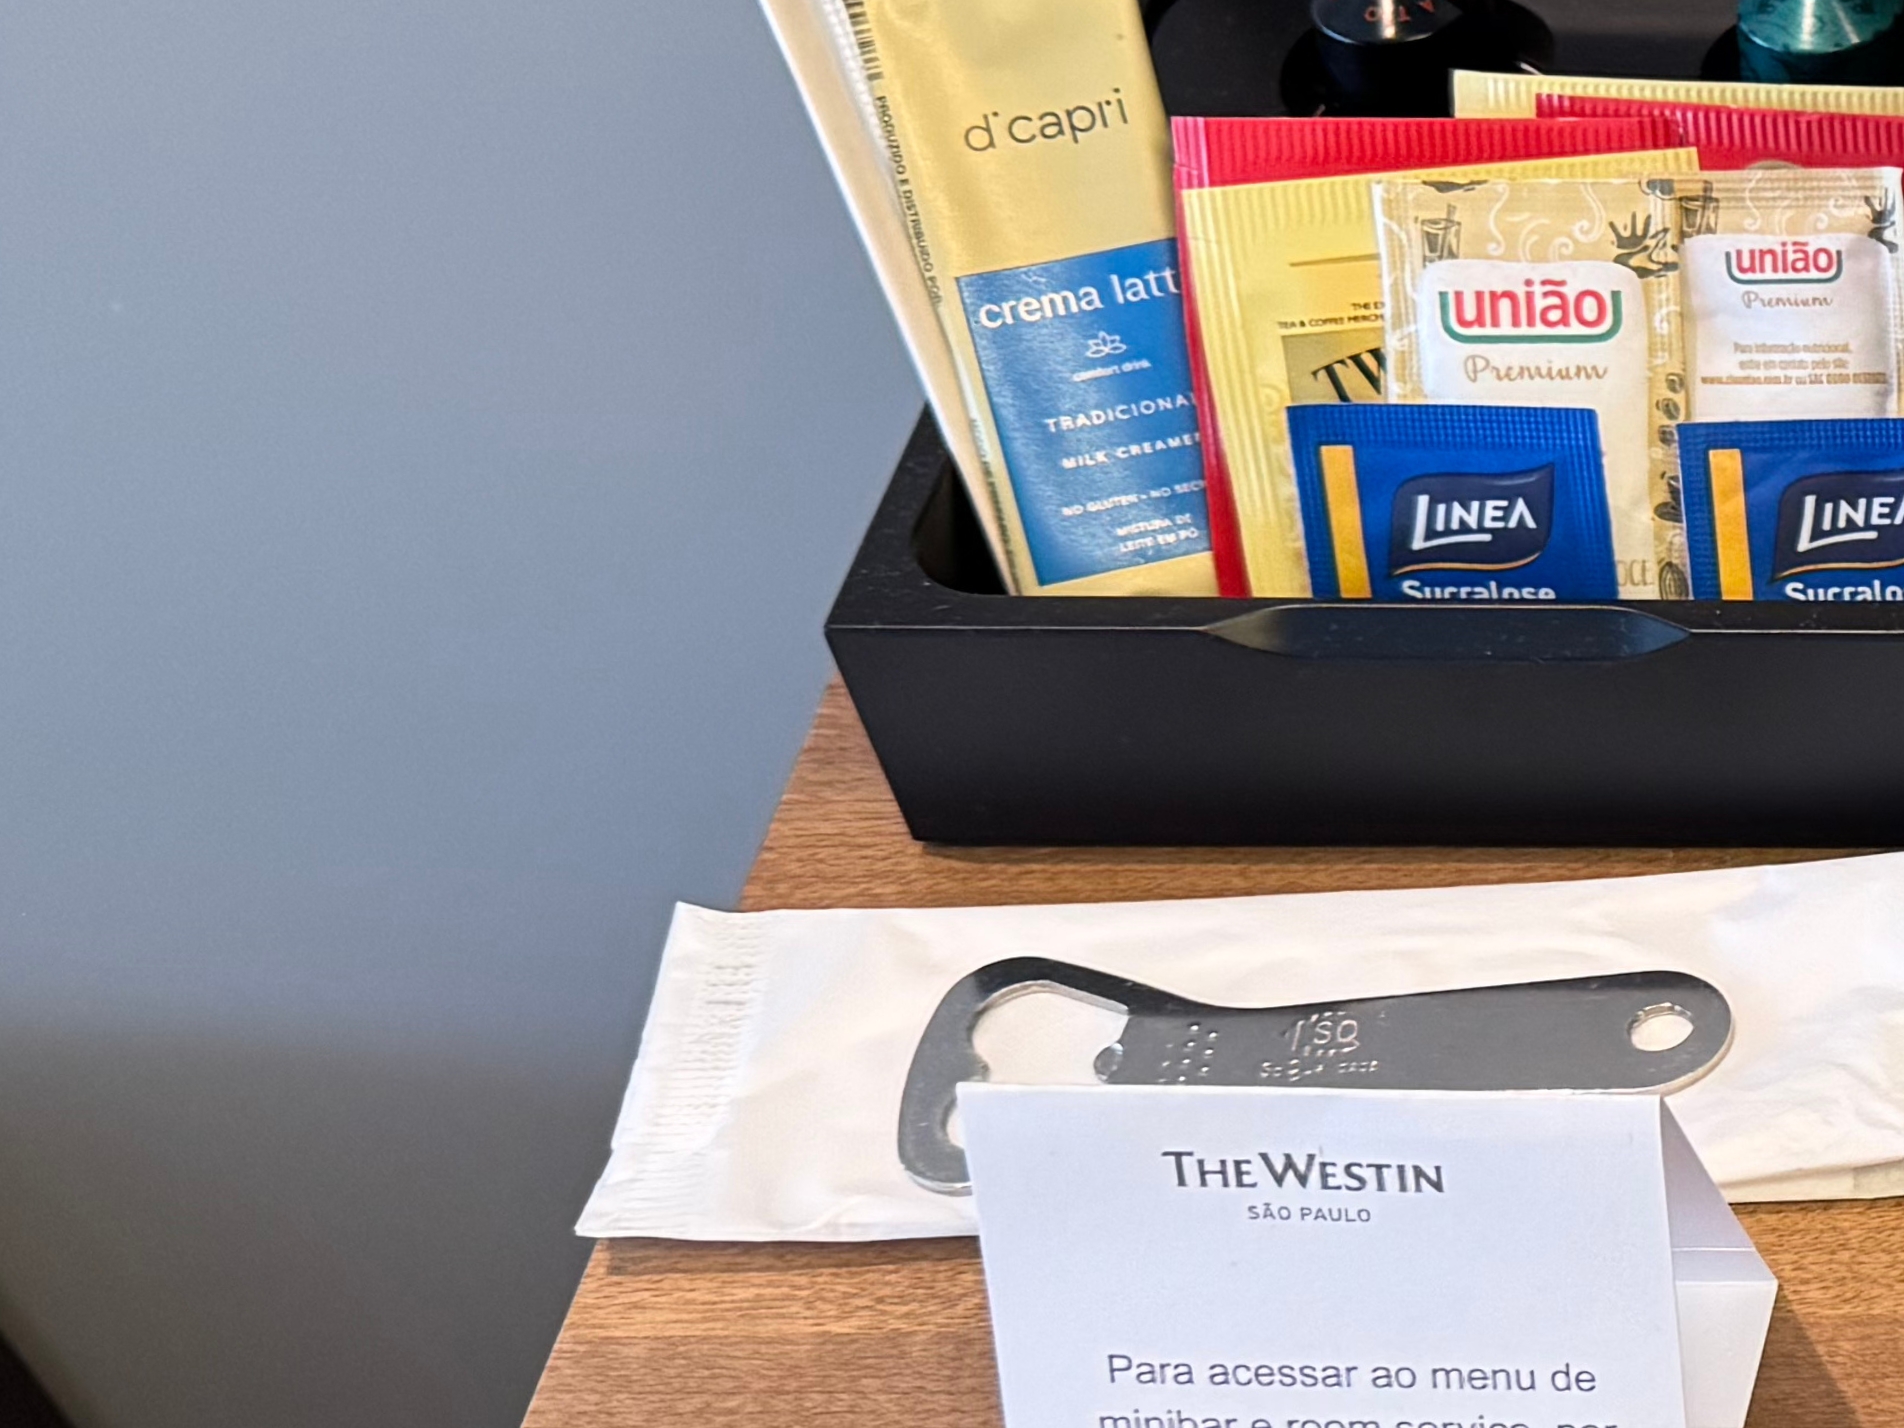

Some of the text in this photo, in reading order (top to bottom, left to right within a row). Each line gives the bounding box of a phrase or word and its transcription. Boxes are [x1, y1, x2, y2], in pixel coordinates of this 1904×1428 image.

[963, 87, 1130, 152] d'capri
[1735, 241, 1838, 275] união
[977, 266, 1182, 329] crema latt
[1453, 278, 1608, 330] união
[1742, 290, 1834, 310] Premium
[1464, 354, 1608, 384] Premium
[1061, 449, 1111, 470] MILK
[1411, 494, 1538, 551] LINEA
[1161, 1150, 1445, 1194] THE WESTIN
[1247, 1202, 1371, 1223] SÃO PAULO
[1107, 1353, 1598, 1393] Para acessar ao menu de
